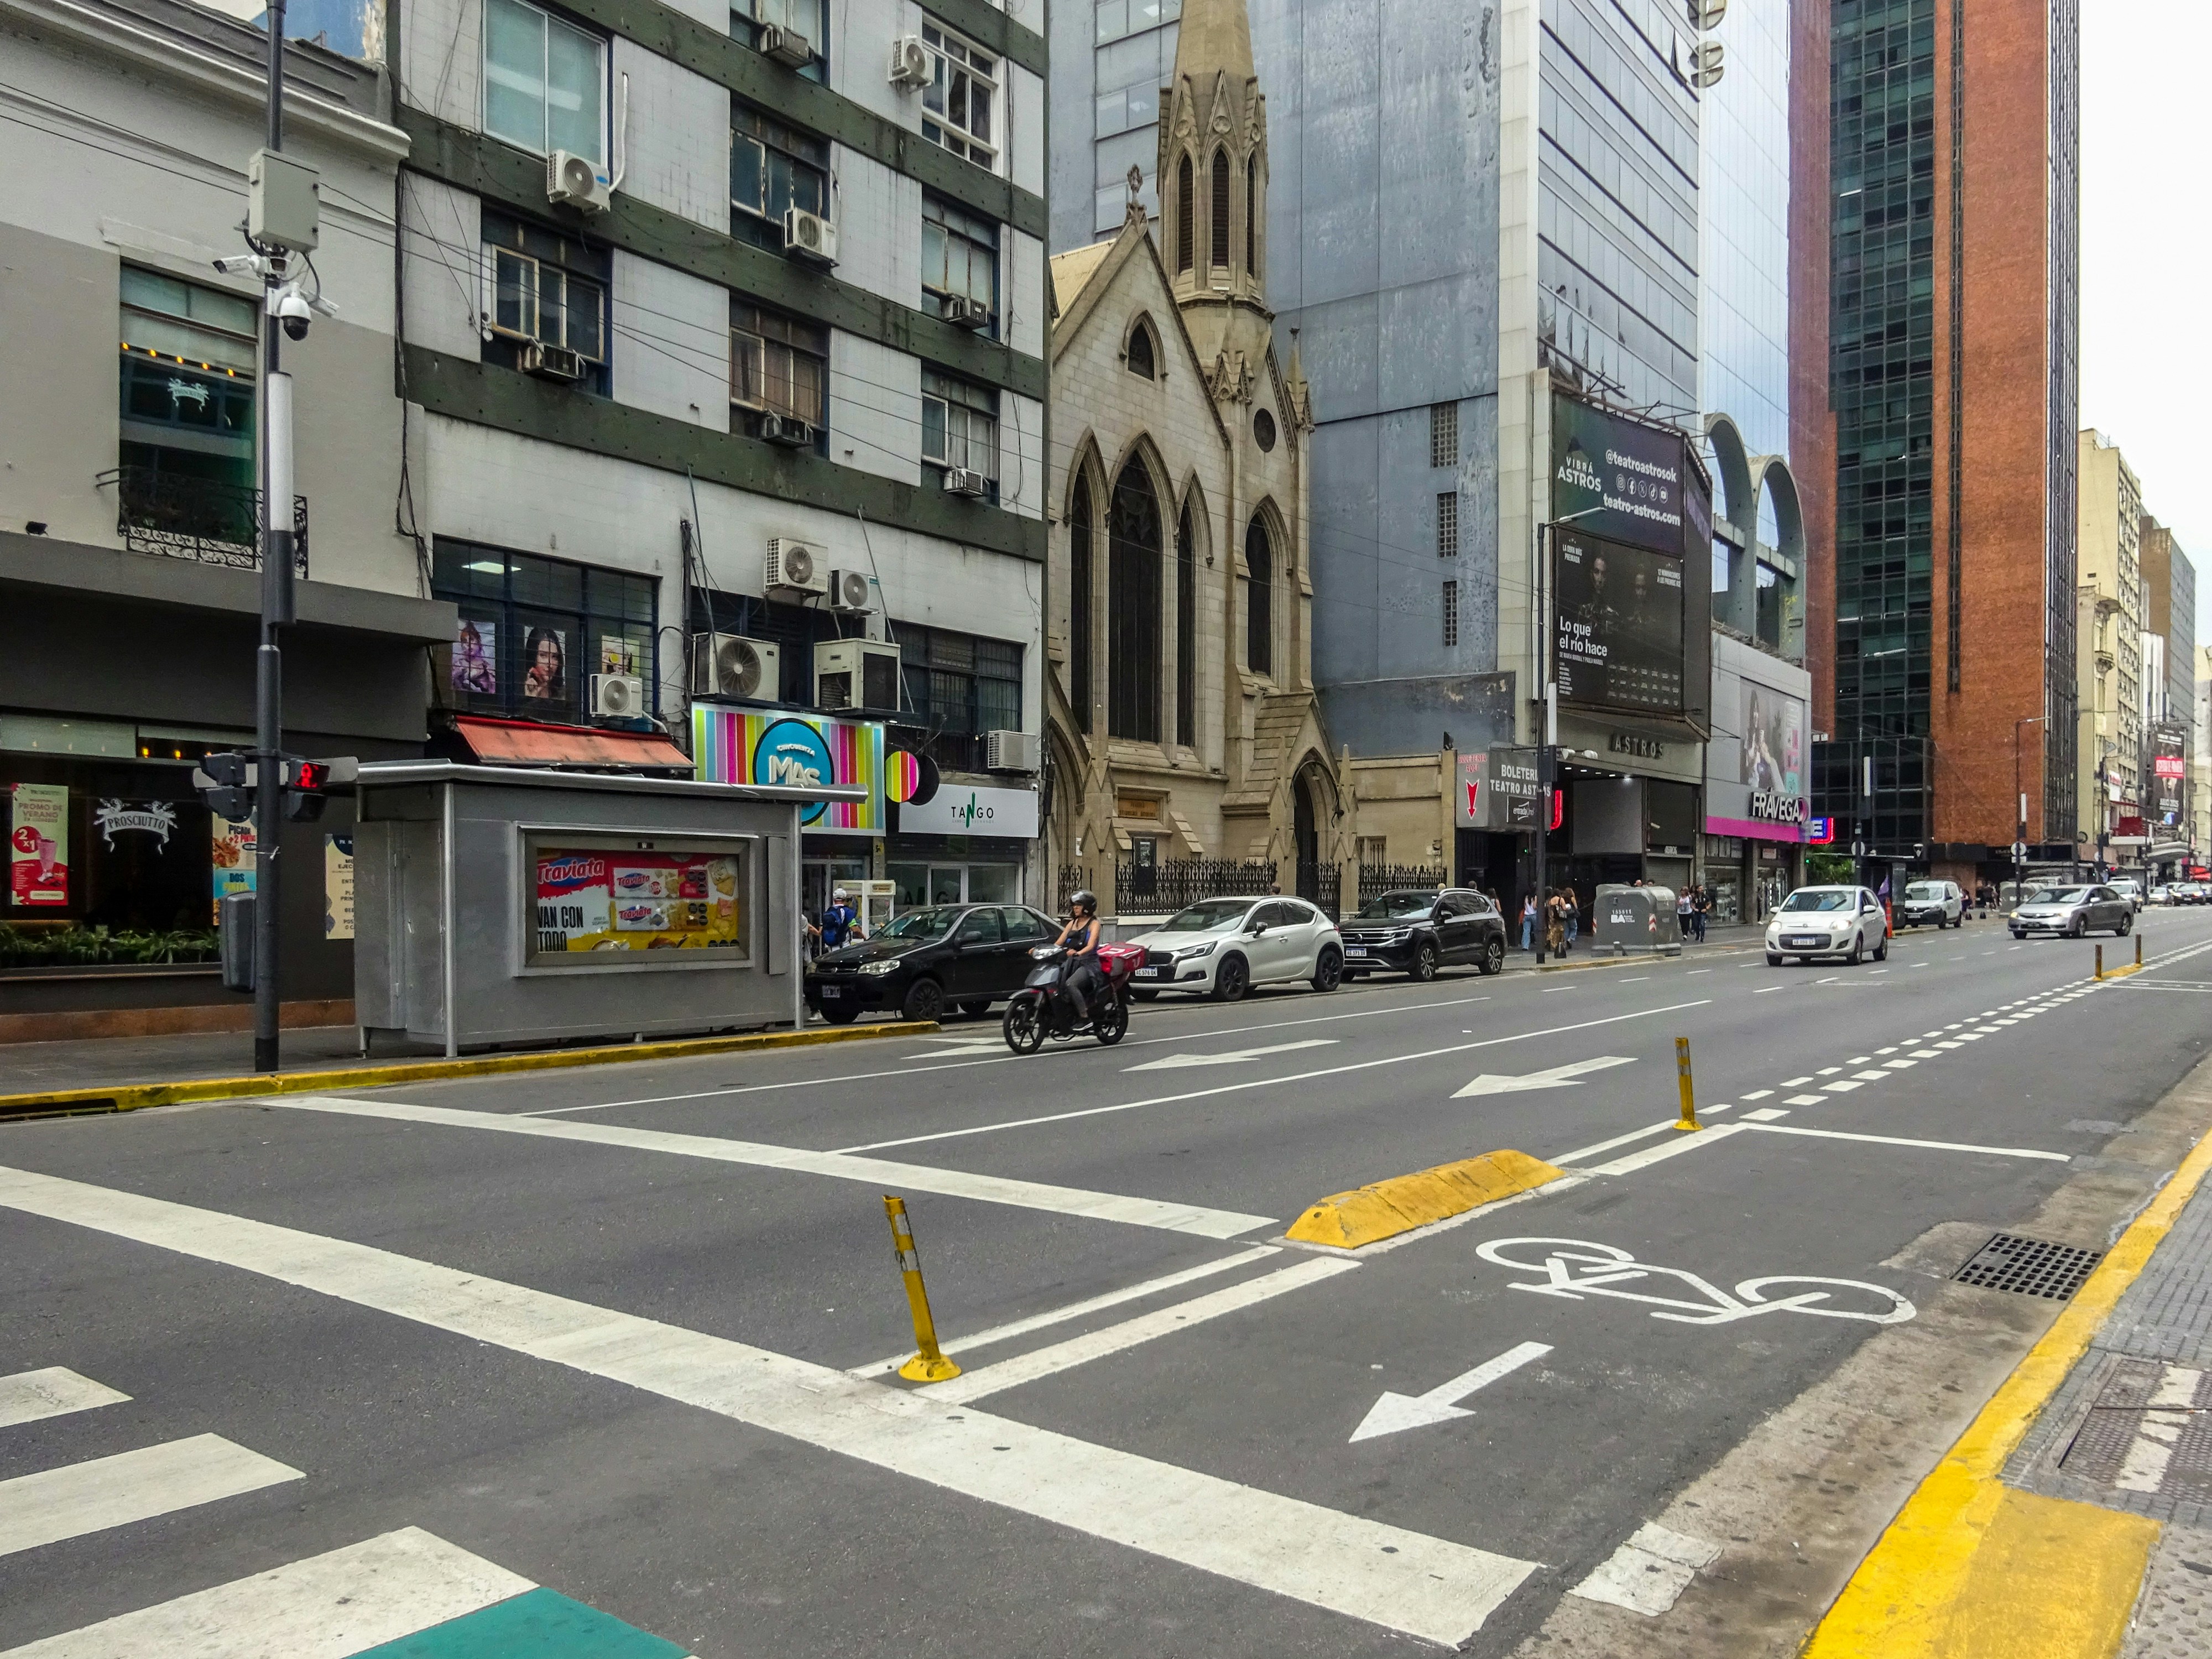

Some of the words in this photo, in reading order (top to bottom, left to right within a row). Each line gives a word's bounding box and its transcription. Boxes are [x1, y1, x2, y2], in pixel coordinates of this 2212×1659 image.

[1566, 456, 1593, 474] VIBRÁ
[1605, 449, 1677, 483] @teatroastrosok
[1557, 466, 1601, 492] ASTROS
[1603, 493, 1681, 526] teatro-astros.com
[1559, 615, 1572, 632] Lo
[1573, 622, 1591, 638] que
[1559, 634, 1568, 649] el
[1571, 637, 1583, 652] río
[1585, 639, 1608, 656] hace
[1614, 734, 1663, 759] ASTROS
[1458, 753, 1487, 764] BOLETERIA
[768, 755, 821, 785] MAS
[1501, 764, 1539, 782] BOLETERI
[1490, 779, 1521, 795] TEATRO
[18, 802, 51, 811] PROMO
[22, 810, 59, 818] VERANO
[951, 791, 994, 829] TANGO
[1752, 787, 1803, 823] FRÁVEGA
[107, 815, 166, 830] PROSCIUTTO
[18, 828, 28, 841] 2
[537, 858, 605, 885] Traviata
[617, 875, 650, 886] Traviata
[538, 906, 558, 928] VAN
[561, 906, 584, 928] CON
[538, 931, 568, 952] TODO
